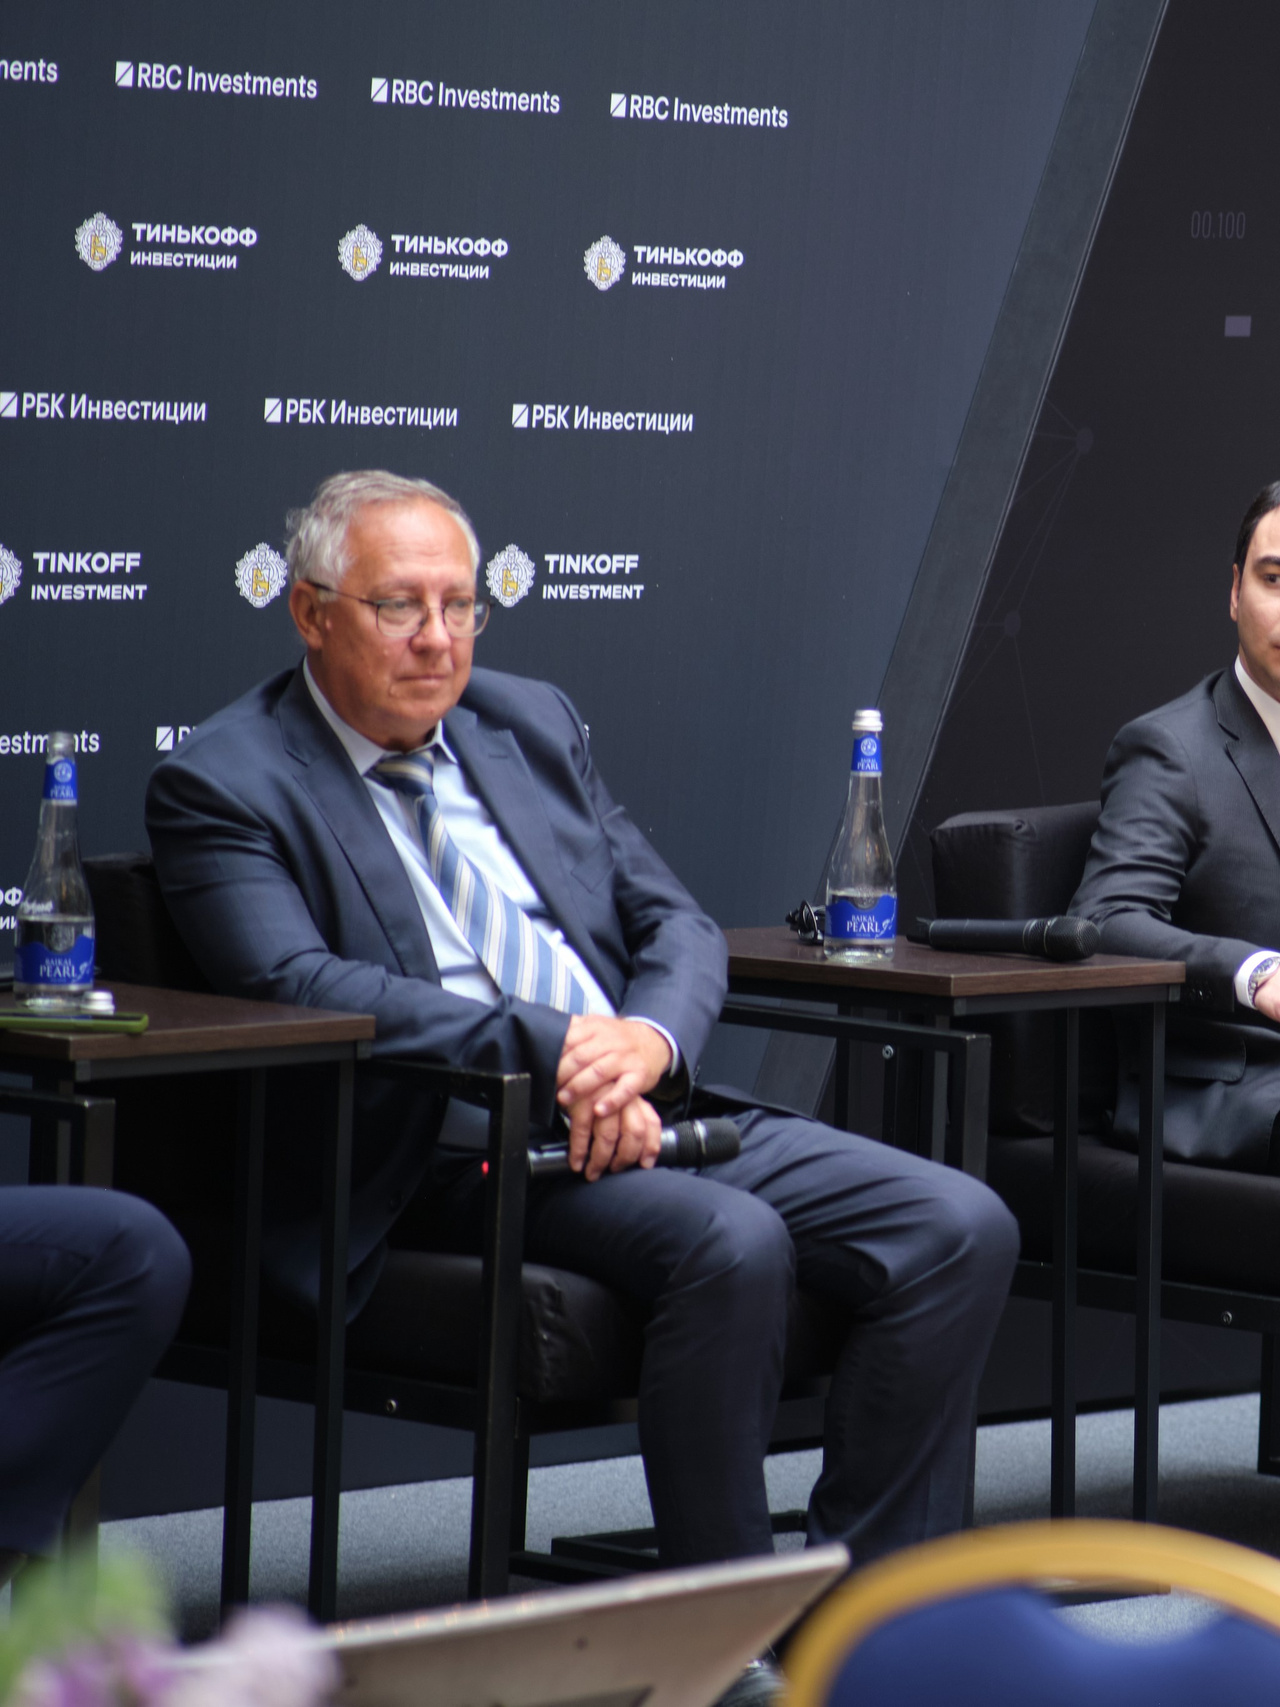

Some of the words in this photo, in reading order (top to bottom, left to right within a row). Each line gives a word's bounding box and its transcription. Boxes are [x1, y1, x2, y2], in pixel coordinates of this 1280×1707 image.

[137, 62, 182, 90] RBC
[187, 65, 318, 99] Investments
[391, 78, 434, 106] RBC
[438, 81, 560, 114] Investments
[629, 94, 670, 121] RBC
[673, 97, 788, 128] Investments
[131, 222, 258, 247] ТИНЬКОФФ
[390, 234, 509, 258] ТИНЬКОФФ
[130, 250, 237, 271] ИНВЕСТИЦИИ
[633, 245, 744, 269] ТИНЬКОФФ
[389, 261, 490, 281] ИНВЕСТИЦИИ
[631, 271, 726, 290] ИНВЕСТИЦИИ
[21, 392, 65, 419] РБК
[70, 393, 207, 425] Инвестиции
[285, 398, 326, 424] РБК
[330, 399, 458, 430] Инвестиции
[531, 404, 570, 429] РБК
[573, 405, 694, 435] Инвестиции
[32, 551, 141, 574] TINKOFF
[544, 553, 640, 575] TINKOFF
[30, 584, 148, 601] INVESTMENT
[542, 584, 645, 600] INVESTMENT
[846, 920, 880, 933] PEARL
[851, 914, 876, 923] BAIKAL
[39, 964, 77, 978] PEARL
